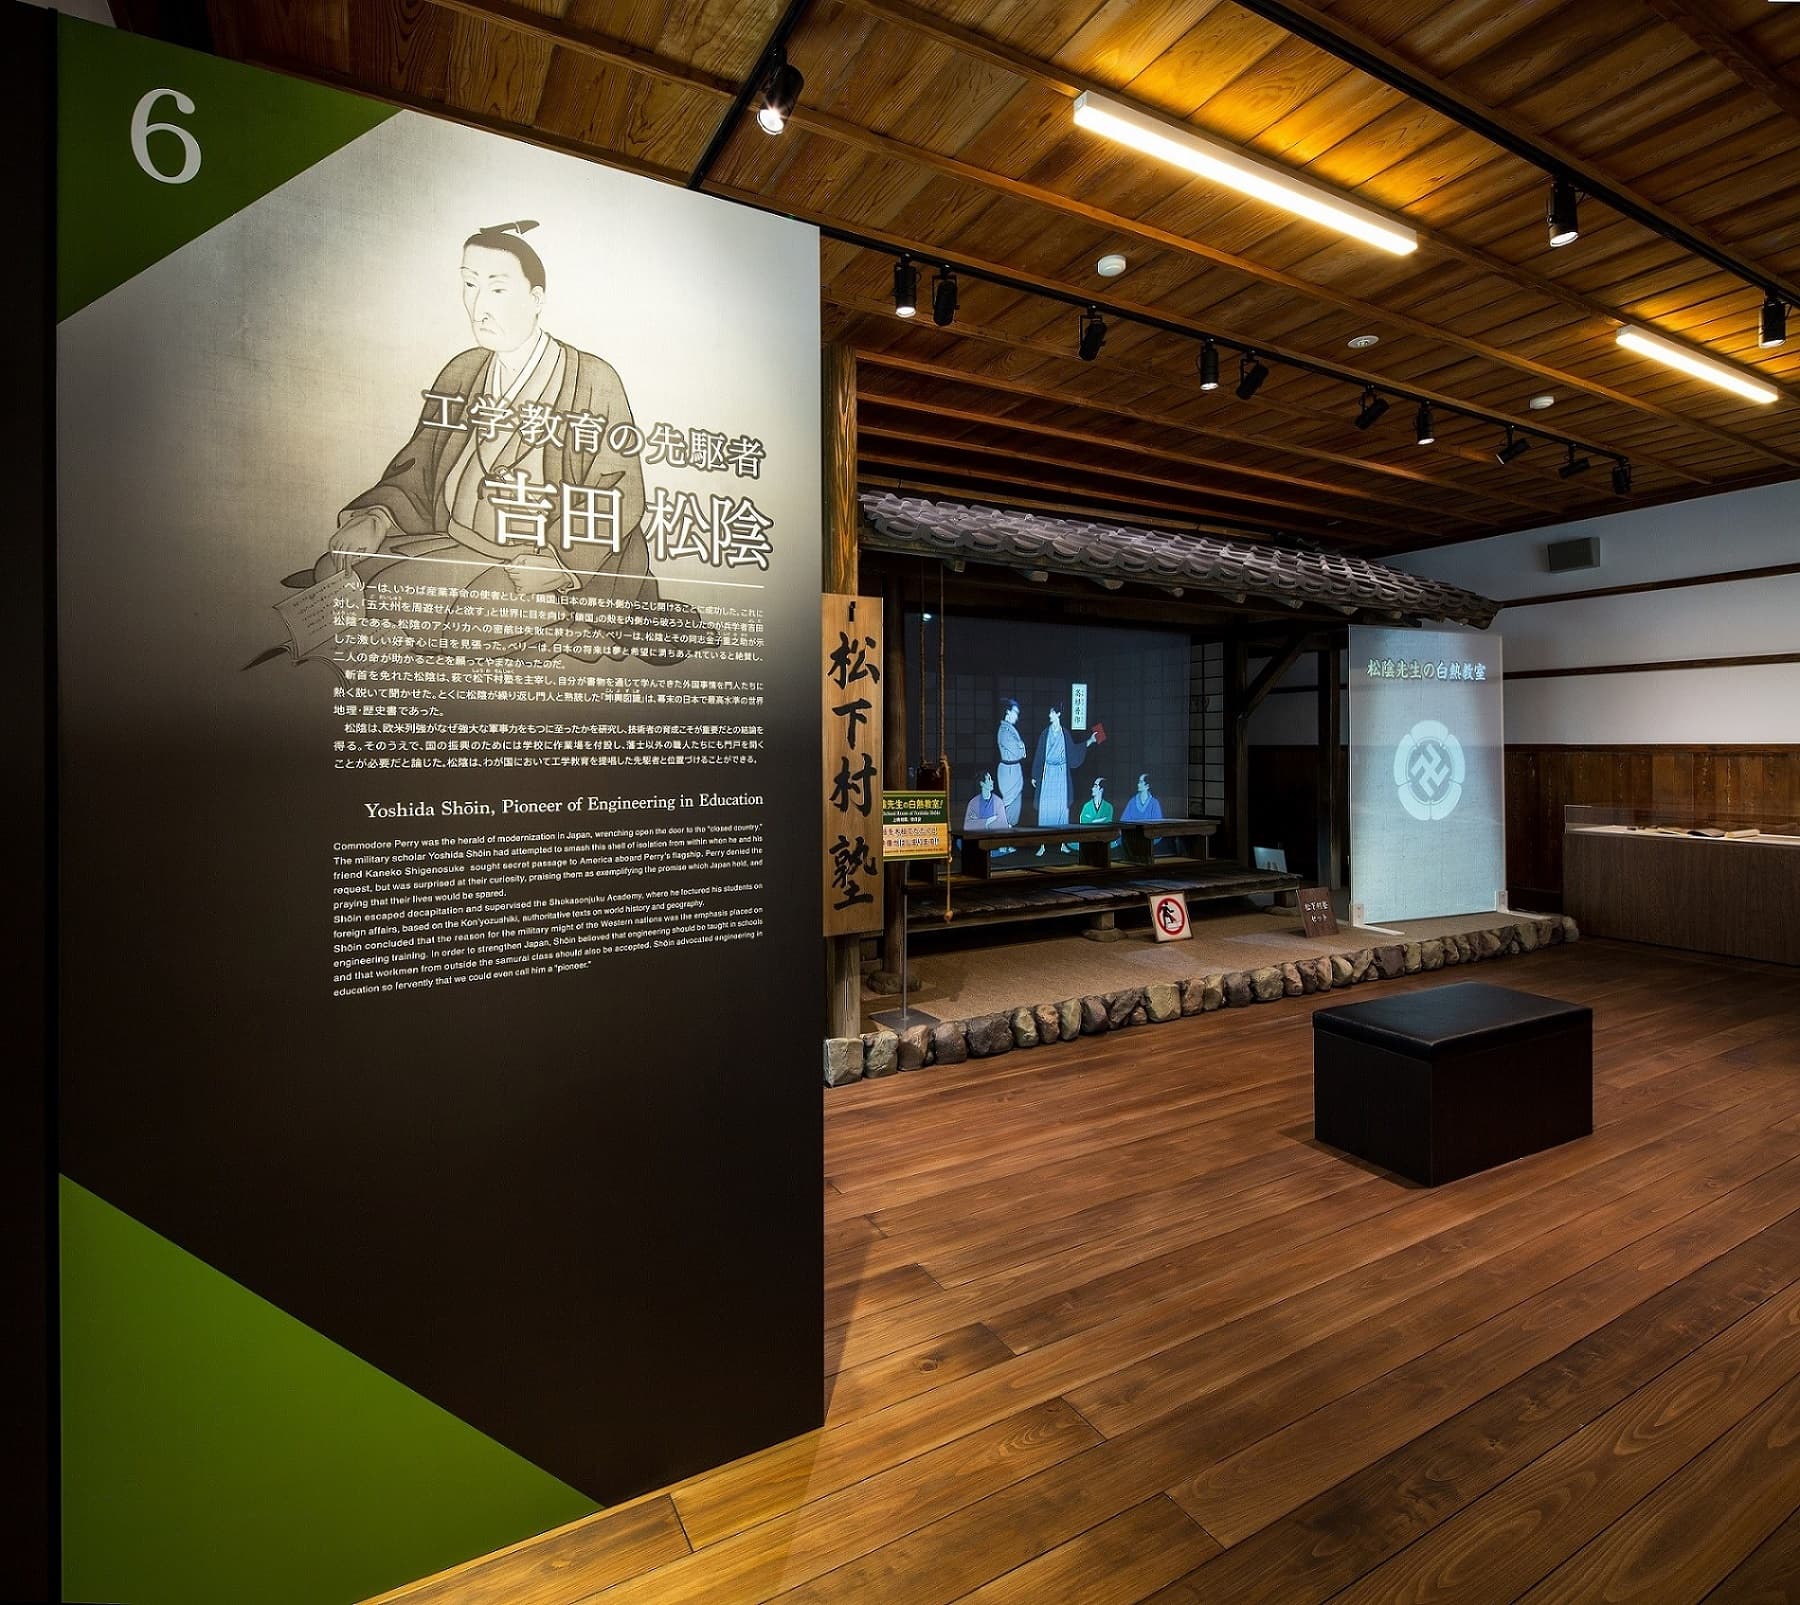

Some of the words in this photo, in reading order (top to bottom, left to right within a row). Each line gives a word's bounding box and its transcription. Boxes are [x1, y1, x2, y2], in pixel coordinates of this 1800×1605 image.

[130, 88, 202, 184] 6
[423, 390, 764, 477] 工学教育の先駆者
[485, 471, 625, 552] 吉田
[645, 488, 772, 569] 松陰
[1367, 658, 1486, 681] 松陰先生の白熱教室
[333, 705, 443, 716] 地理・歴史書であった。
[827, 631, 880, 910] 松下村塾
[364, 800, 435, 818] Yoshida
[441, 800, 495, 817] Shōin,
[501, 799, 563, 814] Pioneer
[566, 796, 584, 812] of
[587, 795, 676, 813] Engineering
[679, 793, 694, 808] in
[698, 792, 763, 807] Education
[332, 841, 392, 850] Commodore
[394, 839, 419, 848] Perry
[440, 837, 456, 845] the
[457, 835, 485, 844] herald
[486, 834, 496, 843] of
[496, 832, 555, 842] modernization
[557, 831, 565, 839] in
[332, 856, 352, 865] The
[354, 855, 390, 864] military
[391, 852, 426, 862] scholar
[427, 850, 464, 859] Yoshida
[492, 847, 509, 856] had
[510, 846, 552, 855] attempted
[554, 845, 562, 853] to
[563, 844, 590, 852] smash
[332, 870, 362, 879] friend
[364, 868, 402, 877] Kaneko
[404, 864, 464, 876] Shigenosuke
[470, 862, 500, 871] sought
[502, 860, 530, 869] secret
[531, 859, 567, 868] passage
[374, 882, 390, 891] but
[392, 882, 411, 890] was
[413, 878, 455, 889] surprised
[456, 878, 466, 886] at
[467, 876, 487, 885] their
[528, 872, 561, 882] praising
[332, 899, 368, 910] praying
[370, 897, 388, 906] that
[389, 895, 410, 904] their
[412, 895, 432, 903] lives
[434, 892, 460, 901] would
[462, 891, 474, 899] be
[364, 910, 405, 921] escaped
[406, 906, 464, 917] decapitation
[465, 903, 482, 913] and
[484, 900, 532, 911] supervised
[533, 899, 547, 907] the
[332, 928, 366, 938] foreign
[368, 925, 400, 935] affairs,
[401, 922, 430, 932] based
[444, 919, 459, 928] the
[364, 937, 414, 949] concluded
[416, 935, 435, 944] that
[454, 932, 485, 941] reason
[487, 930, 500, 938] for
[501, 928, 516, 937] the
[517, 926, 549, 935] military
[550, 923, 574, 933] might
[332, 955, 389, 968] engineering
[391, 951, 428, 961] training.
[431, 949, 440, 958] In
[441, 947, 465, 956] order
[466, 946, 476, 954] to
[477, 942, 522, 953] strengthen
[332, 972, 352, 982] and
[354, 970, 373, 979] that
[375, 967, 418, 977] workmen
[420, 964, 442, 972] from
[443, 959, 477, 970] outside
[478, 958, 493, 966] the
[494, 954, 530, 964] samurai
[332, 985, 379, 996] education
[381, 983, 393, 991] so
[395, 978, 433, 990] fervently
[434, 975, 452, 985] that
[468, 971, 492, 981] could
[492, 970, 513, 978] even
[530, 966, 546, 974] him
